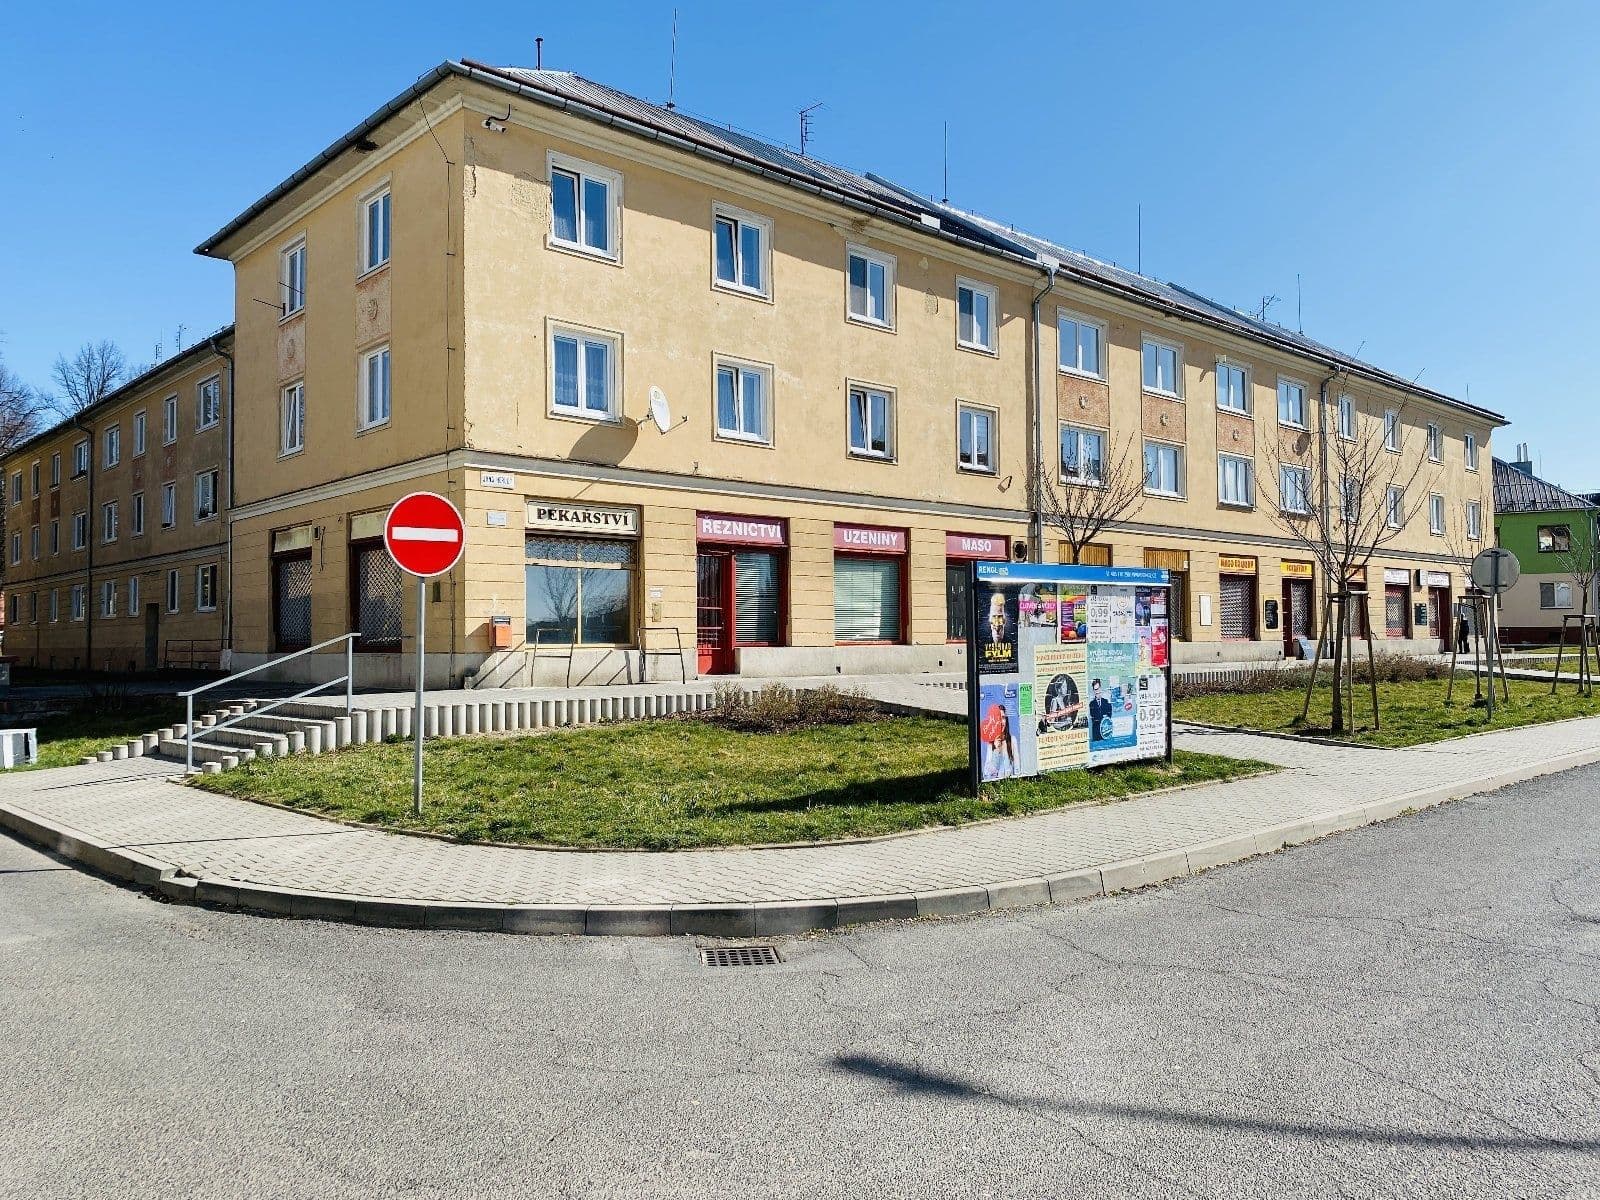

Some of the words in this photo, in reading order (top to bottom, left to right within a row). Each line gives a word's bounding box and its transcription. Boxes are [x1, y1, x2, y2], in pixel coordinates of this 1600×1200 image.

[537, 507, 629, 526] PEKAŘSTVÍ
[702, 515, 781, 538] ŘEZNICTVÍ
[843, 529, 898, 546] UZENINY
[961, 538, 992, 552] MASO
